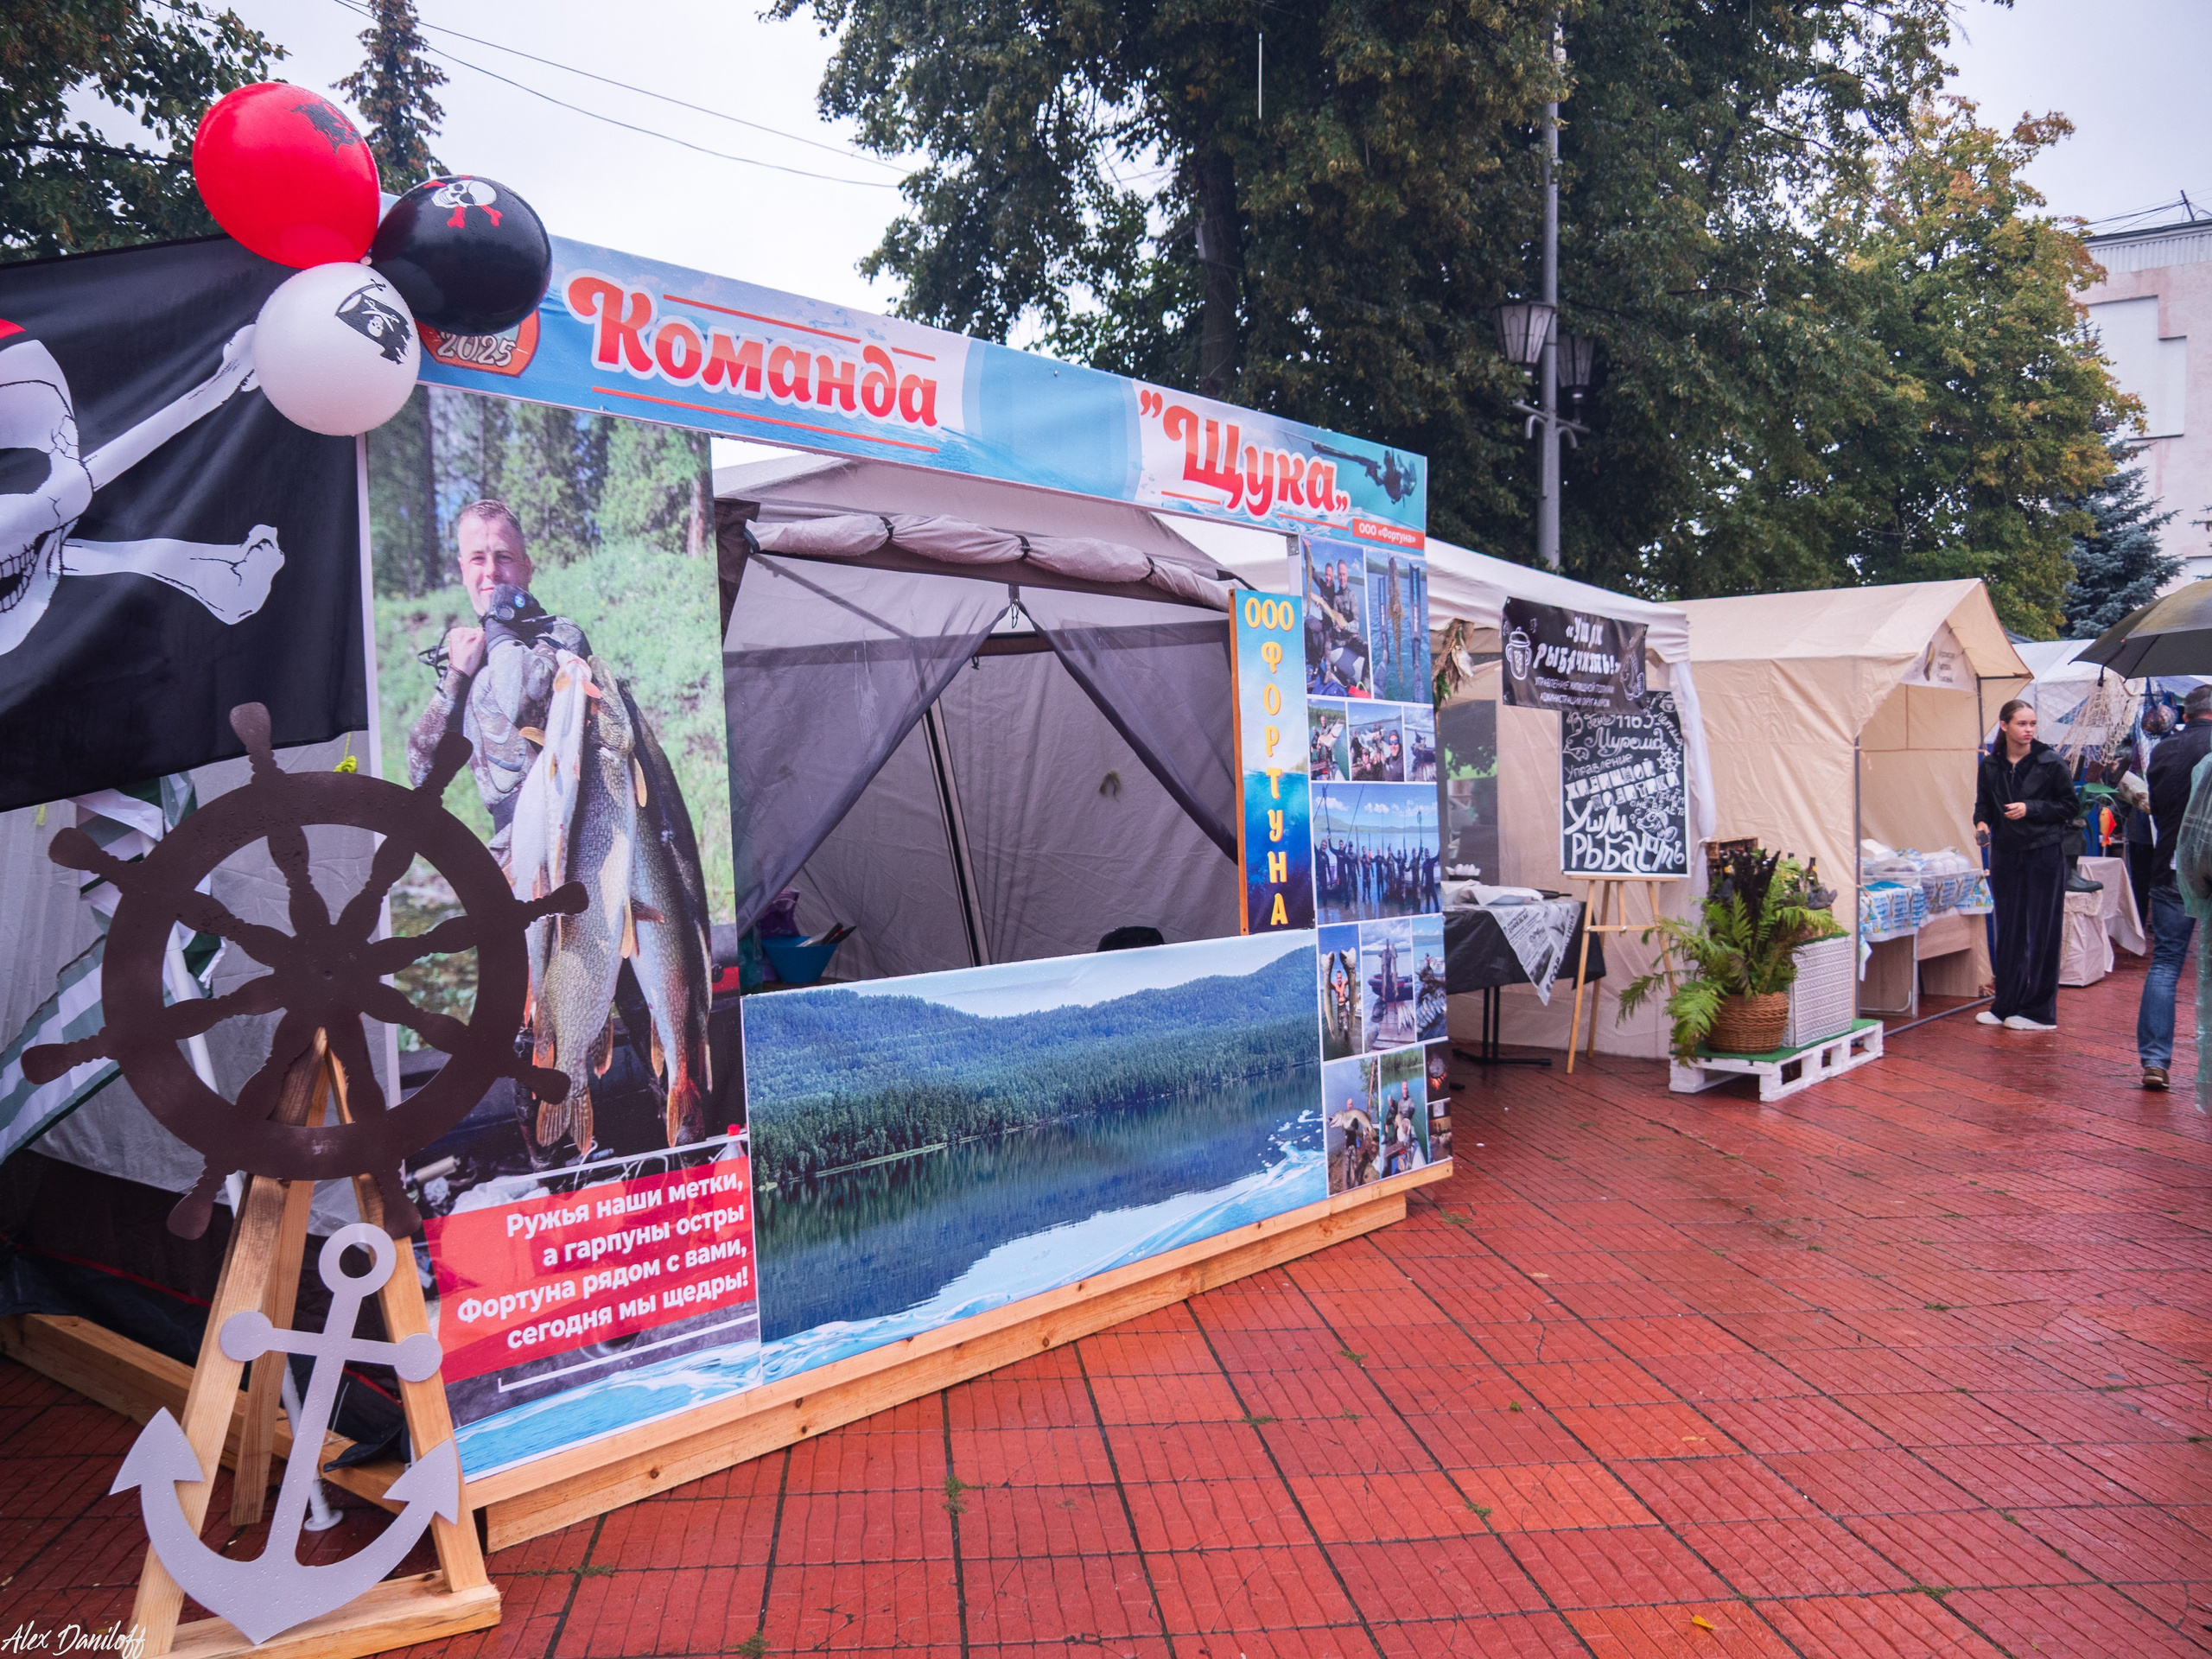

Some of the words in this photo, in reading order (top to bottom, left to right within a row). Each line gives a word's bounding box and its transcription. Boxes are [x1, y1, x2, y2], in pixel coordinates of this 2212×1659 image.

[436, 331, 518, 368] 2025
[568, 275, 938, 429] Команда
[1358, 522, 1376, 536] ООО
[1377, 526, 1416, 544] «Фортуна»
[1244, 596, 1294, 632] ООО
[1564, 753, 1633, 780] Управление
[1584, 727, 1669, 757] Мурома
[505, 1203, 589, 1238] Ружья
[596, 1187, 662, 1219] наши
[668, 1171, 744, 1204] метки,
[543, 1247, 558, 1267] а
[564, 1221, 670, 1262] гарпуны
[676, 1204, 745, 1236] остры
[456, 1279, 576, 1324] Фортуна
[582, 1258, 661, 1296] рядом
[666, 1253, 680, 1272] с
[685, 1238, 747, 1269] вами,
[506, 1306, 613, 1349] сегодня
[618, 1294, 657, 1320] мы
[663, 1267, 749, 1308] щедры!
